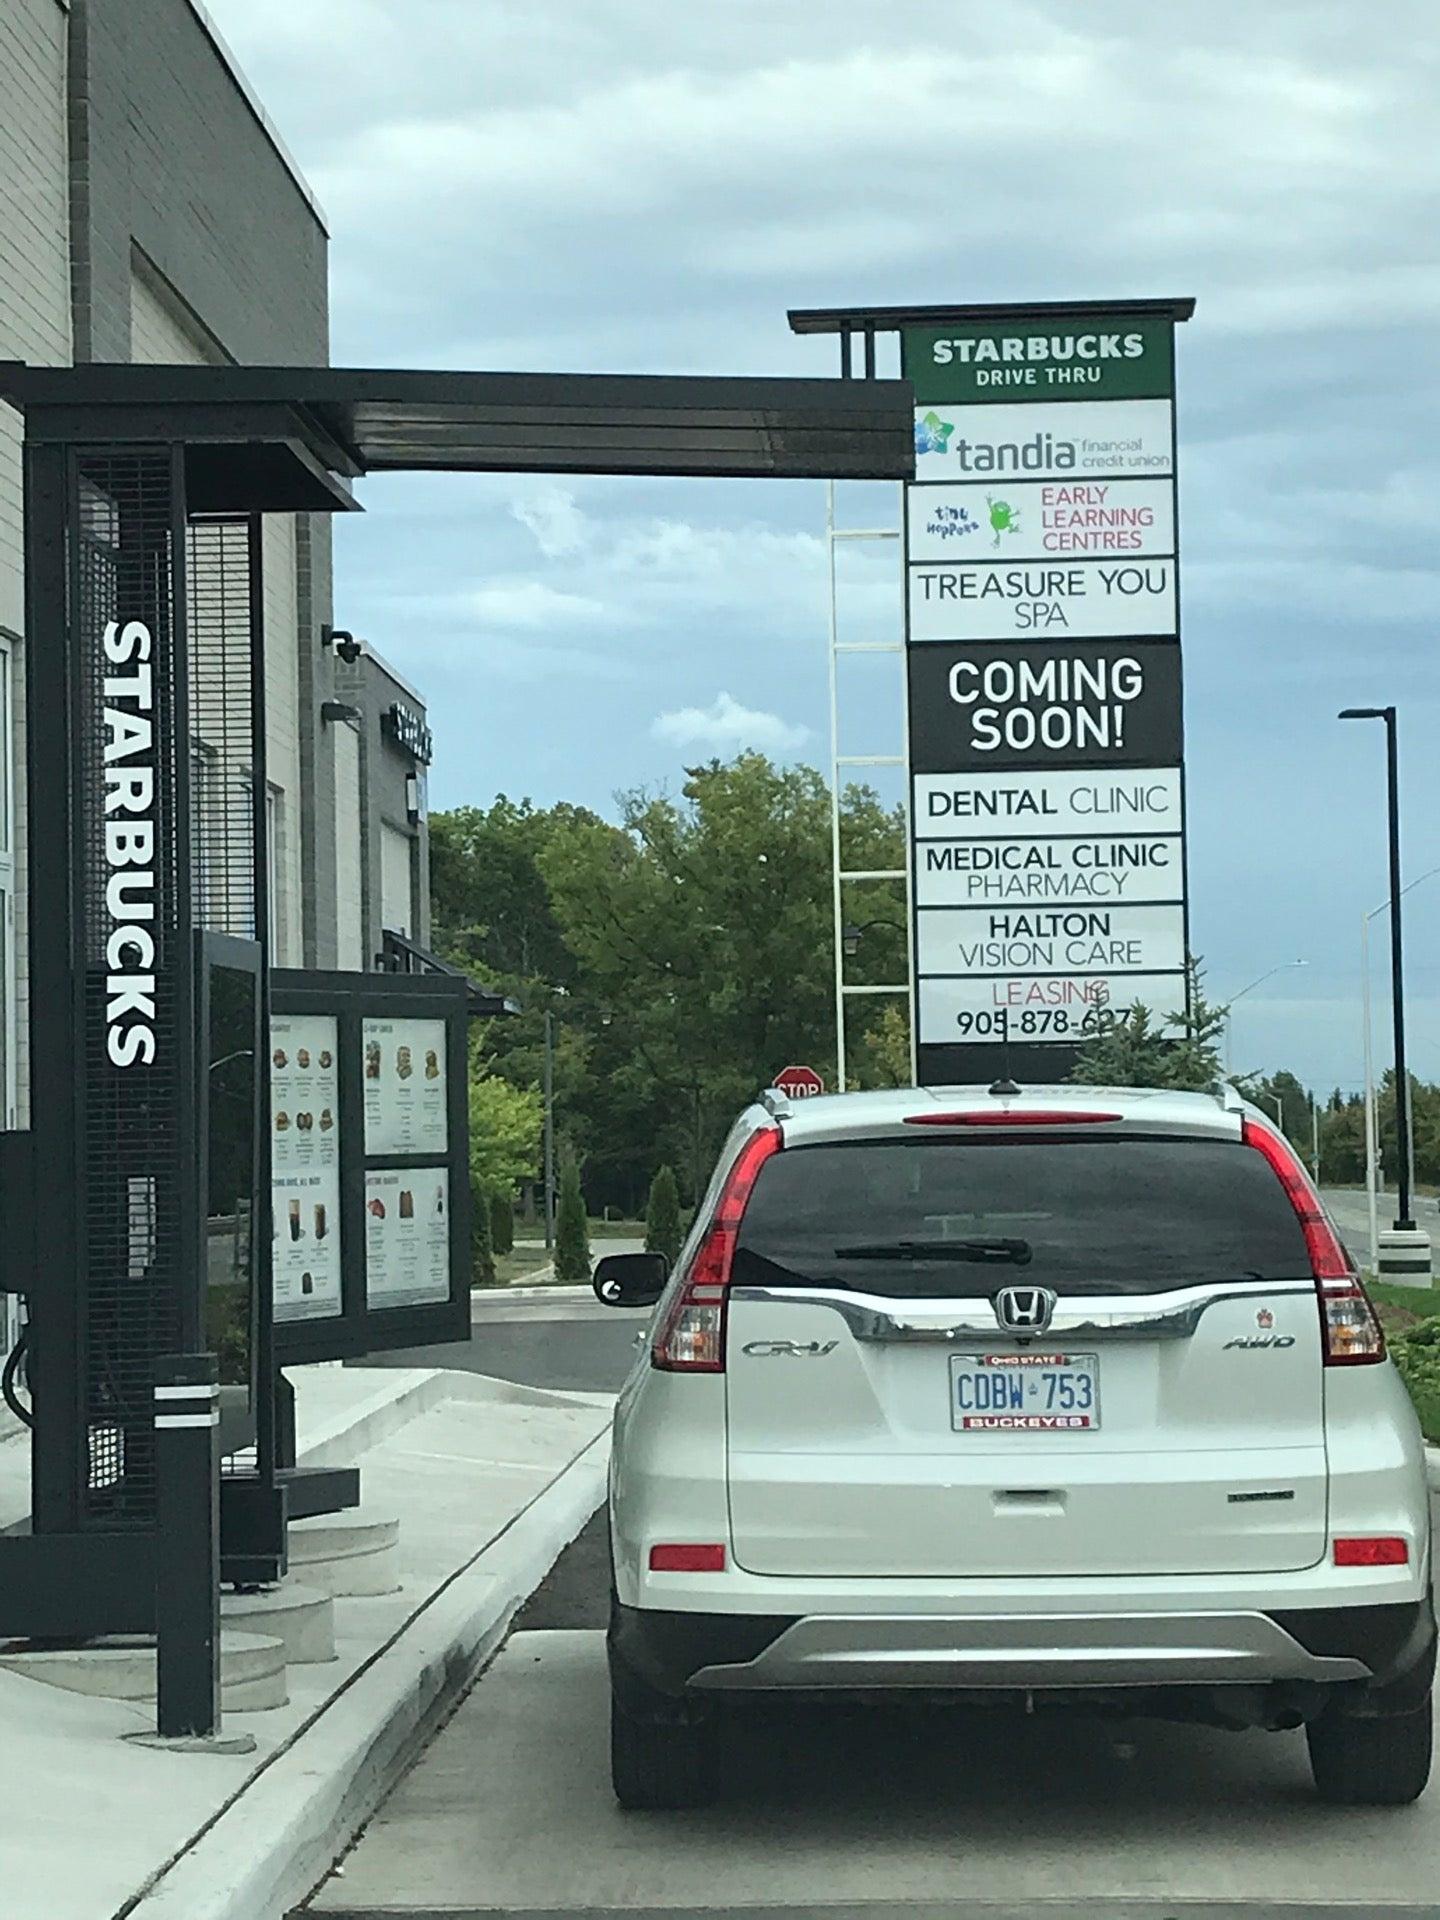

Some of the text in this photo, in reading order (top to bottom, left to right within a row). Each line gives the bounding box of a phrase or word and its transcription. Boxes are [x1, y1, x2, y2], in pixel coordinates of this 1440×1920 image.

[933, 334, 1144, 364] STARBUCKS
[976, 366, 1101, 386] DRIVE THRU
[956, 433, 1076, 471] tandia
[1082, 438, 1142, 452] financial
[1082, 453, 1170, 468] credit union
[1042, 486, 1109, 506] EARLY
[1042, 507, 1154, 529] LEARNING
[1042, 531, 1142, 551] CENTRES
[917, 568, 1166, 600] TREASURE YOU
[1015, 602, 1069, 628] SPA
[949, 658, 1143, 703] COMING
[970, 705, 1123, 750] SOON!
[928, 785, 1169, 817] DENTAL CLINIC
[103, 620, 156, 1067] STARBUCKS
[927, 843, 1169, 870] MEDICAL CLINIC
[967, 872, 1129, 898] PHARMACY
[989, 913, 1111, 938] HALTON
[959, 940, 1142, 967] VISION CARE
[992, 979, 1111, 1006] LEASING
[1222, 1335, 1296, 1351] AWD
[1021, 1356, 1056, 1365] STATE
[958, 1373, 1092, 1410] CDBW 753
[970, 1418, 1083, 1428] BUCKEYES
